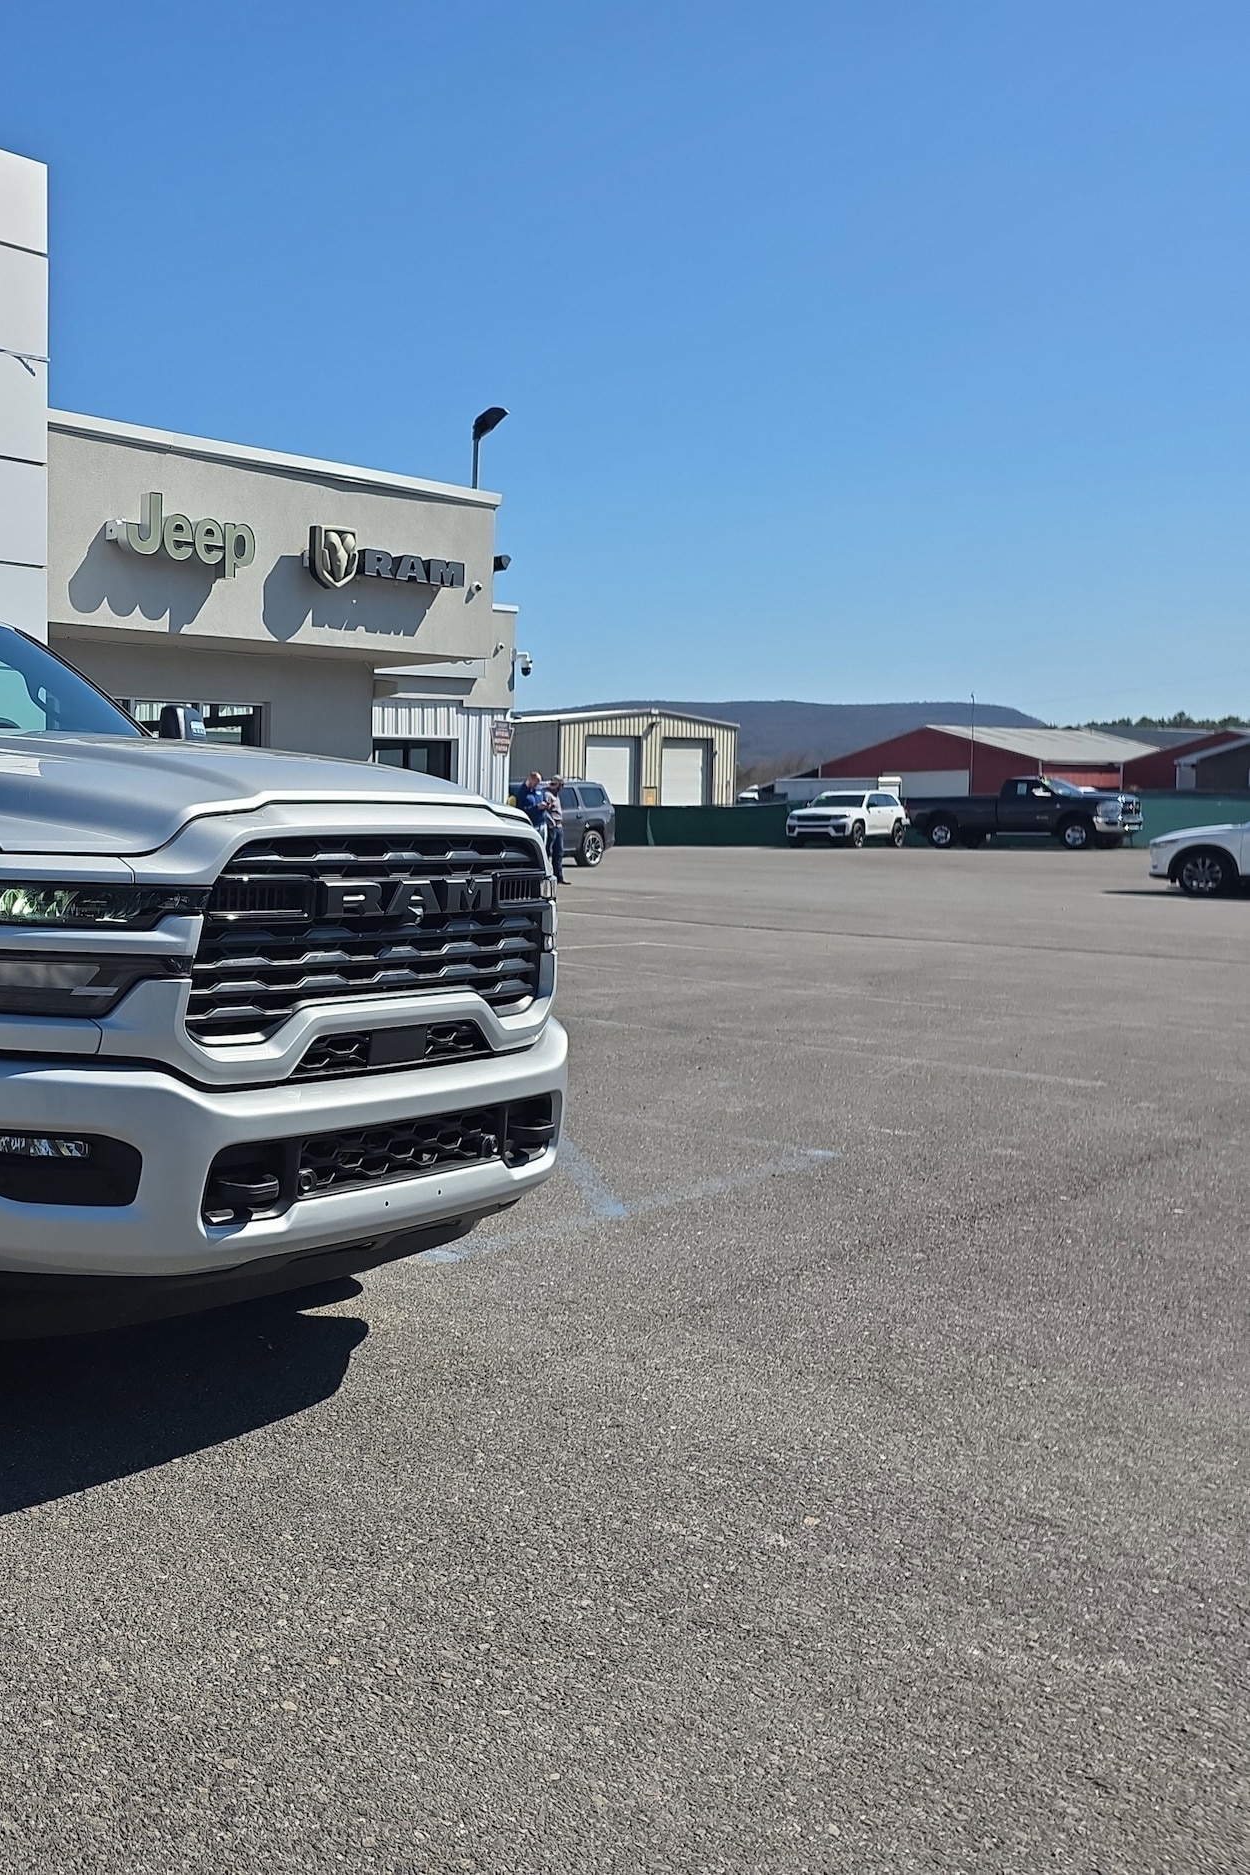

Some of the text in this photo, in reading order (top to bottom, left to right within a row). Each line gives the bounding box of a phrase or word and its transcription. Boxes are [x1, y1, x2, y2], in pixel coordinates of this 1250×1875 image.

[121, 491, 256, 579] Jeep
[360, 548, 466, 588] RAM
[323, 876, 493, 918] RAM
